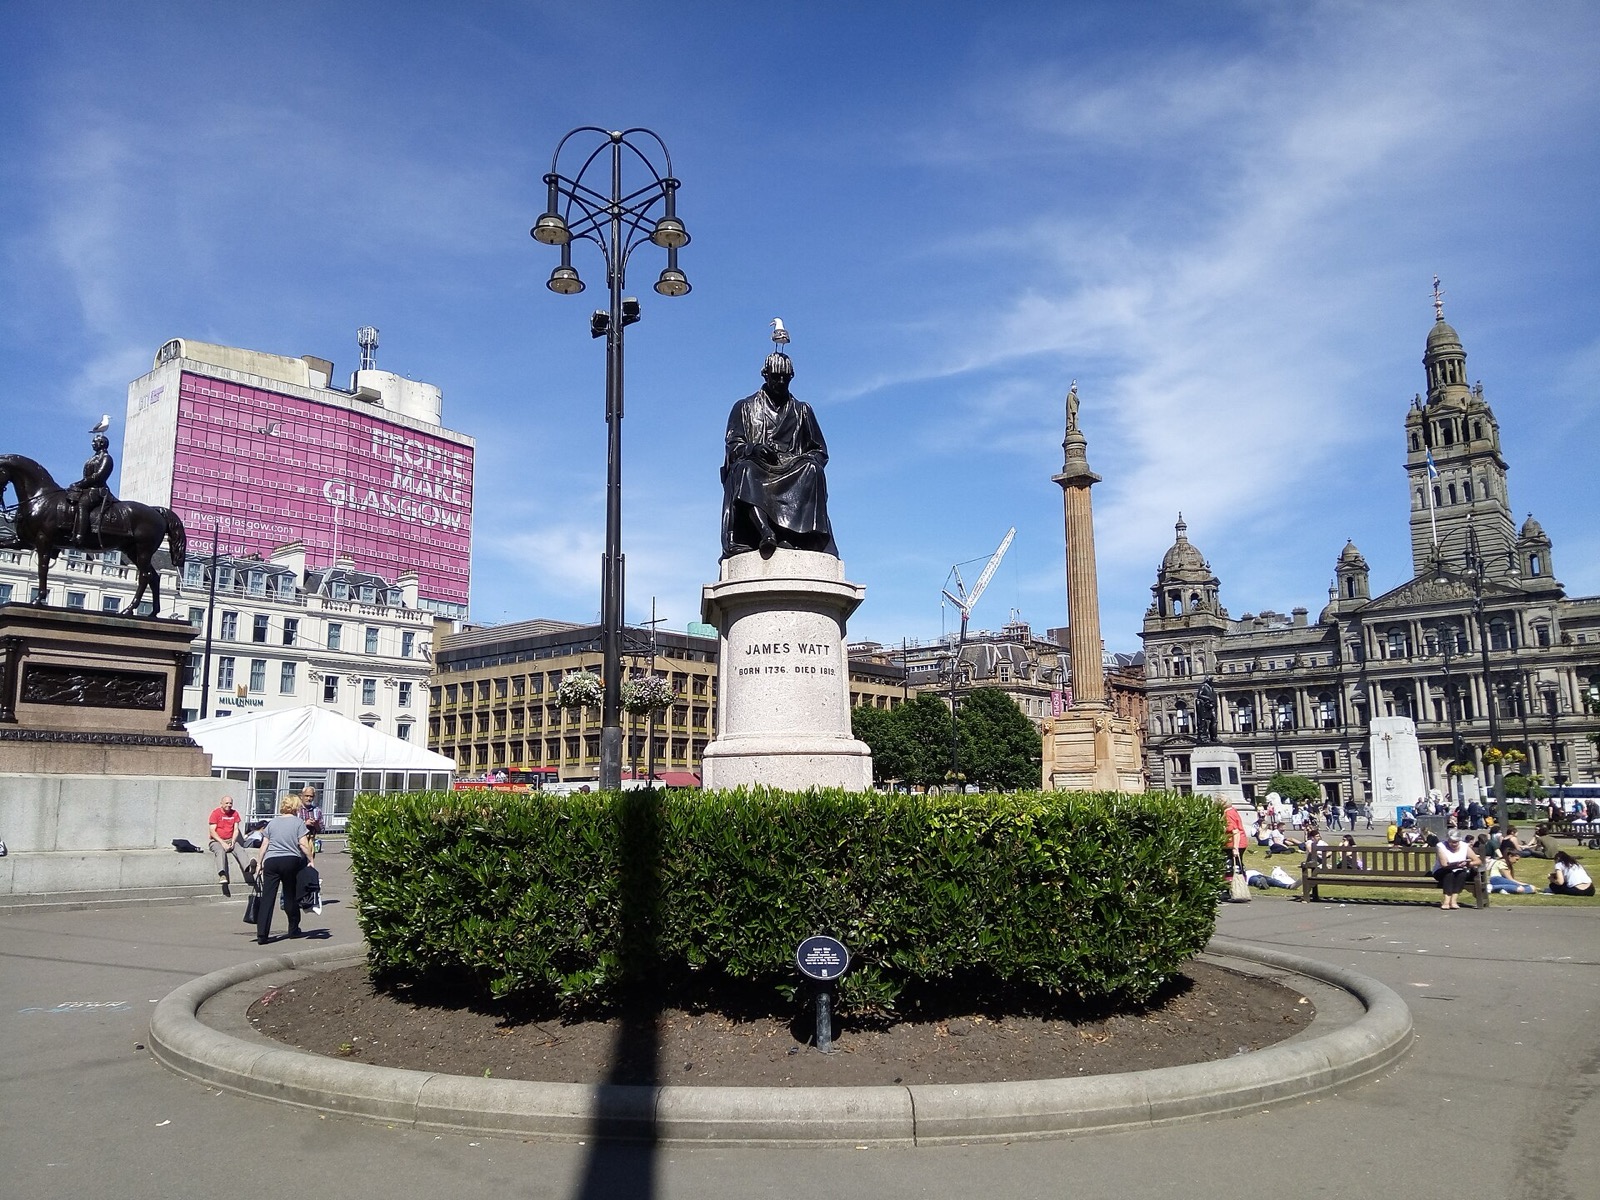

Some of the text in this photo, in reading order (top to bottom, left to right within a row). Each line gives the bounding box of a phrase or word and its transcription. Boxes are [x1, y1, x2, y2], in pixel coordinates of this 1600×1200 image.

[371, 427, 465, 479] PEOPLE
[391, 464, 464, 505] MAKE
[322, 478, 463, 532] GLASGOW
[745, 643, 830, 656] JAMES WATT
[738, 667, 760, 676] BORN
[794, 666, 816, 674] DIED
[218, 697, 264, 707] MILLENNIUM
